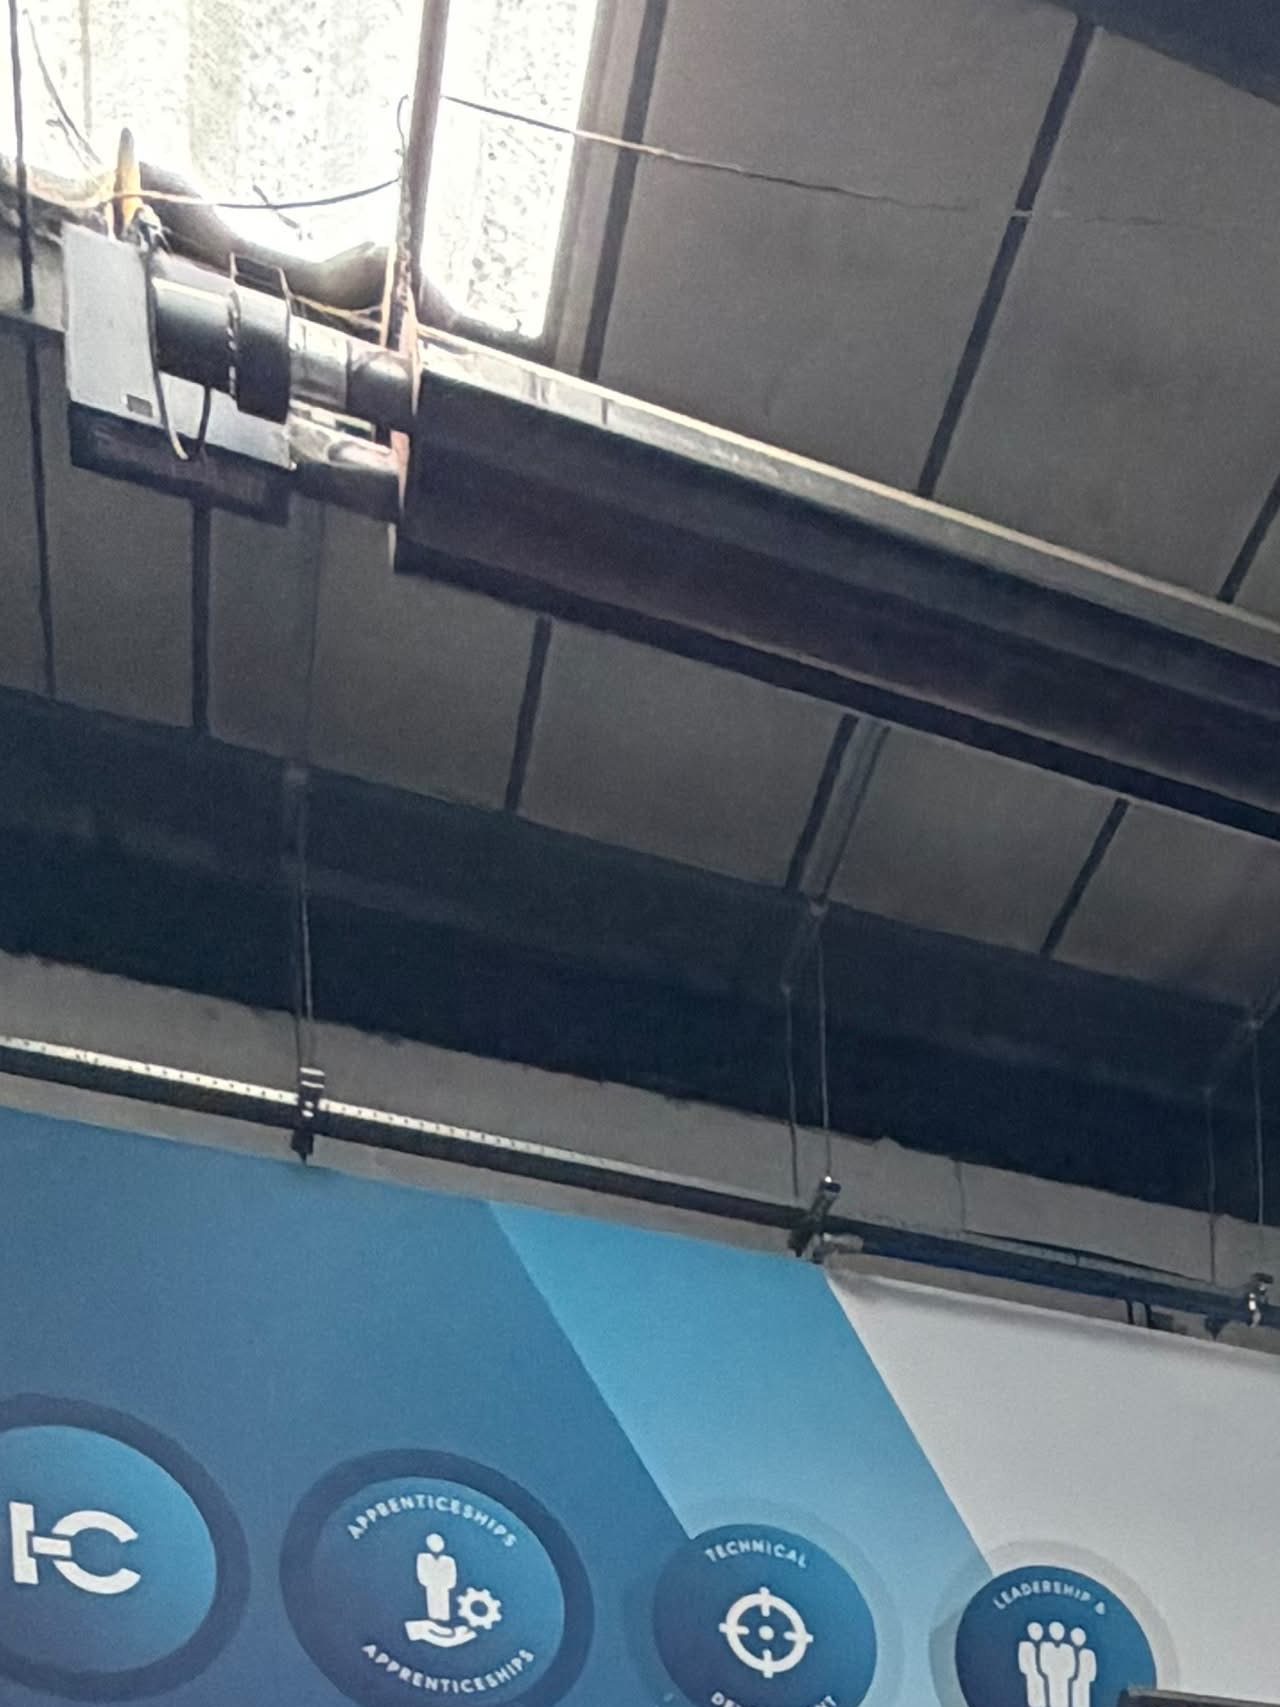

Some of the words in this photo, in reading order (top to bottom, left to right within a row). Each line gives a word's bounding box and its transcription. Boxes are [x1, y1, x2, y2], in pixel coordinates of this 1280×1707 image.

[347, 1494, 518, 1548] APPRENTICESHIPS
[705, 1538, 807, 1569] TECHNICAL
[993, 1579, 1091, 1610] LEADERSHIP
[361, 1644, 535, 1694] APPRENTICESHIPS
